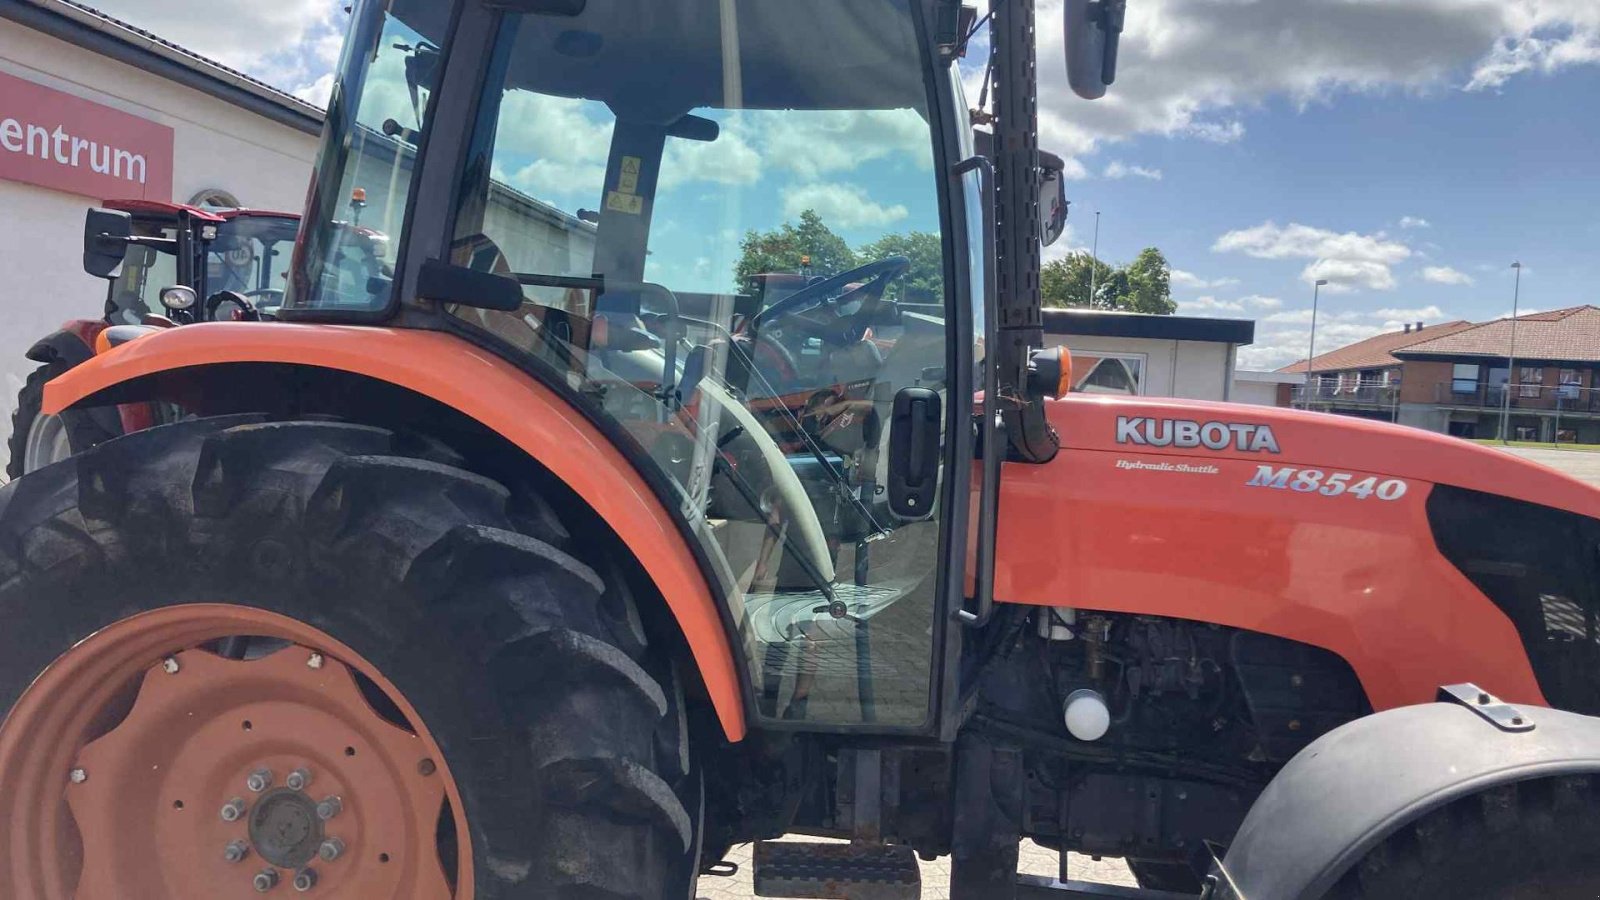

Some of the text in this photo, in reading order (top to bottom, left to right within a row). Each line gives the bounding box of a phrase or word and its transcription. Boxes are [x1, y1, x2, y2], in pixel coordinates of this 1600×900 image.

[0, 118, 146, 184] entrum
[1116, 416, 1280, 453] KUBOTA
[1116, 460, 1219, 474] Hydraulic Shuttle
[1246, 465, 1407, 500] M8540
